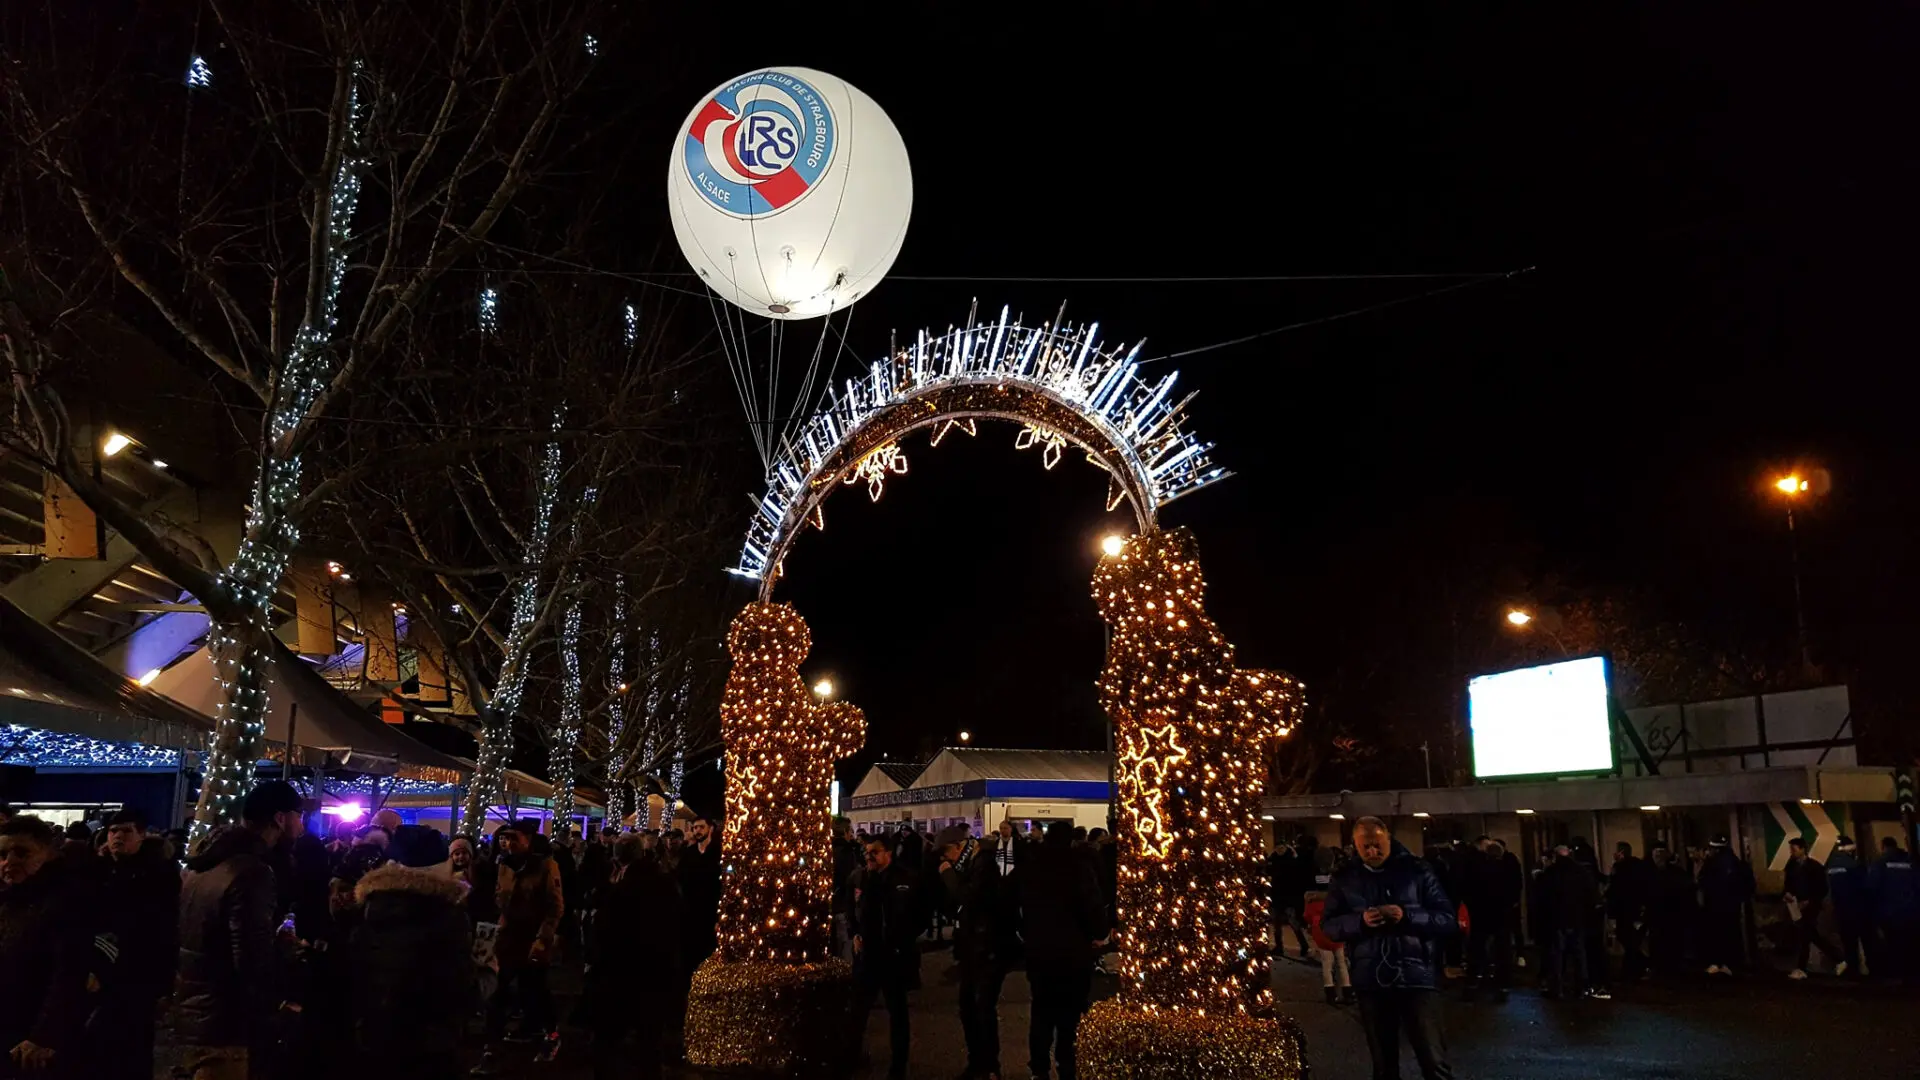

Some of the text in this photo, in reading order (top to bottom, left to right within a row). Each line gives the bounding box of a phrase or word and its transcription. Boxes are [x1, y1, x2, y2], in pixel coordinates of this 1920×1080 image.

[766, 74, 793, 87] CLUB
[792, 83, 807, 96] DE
[804, 94, 827, 169] STRASBOURG
[697, 172, 731, 204] ALSACE
